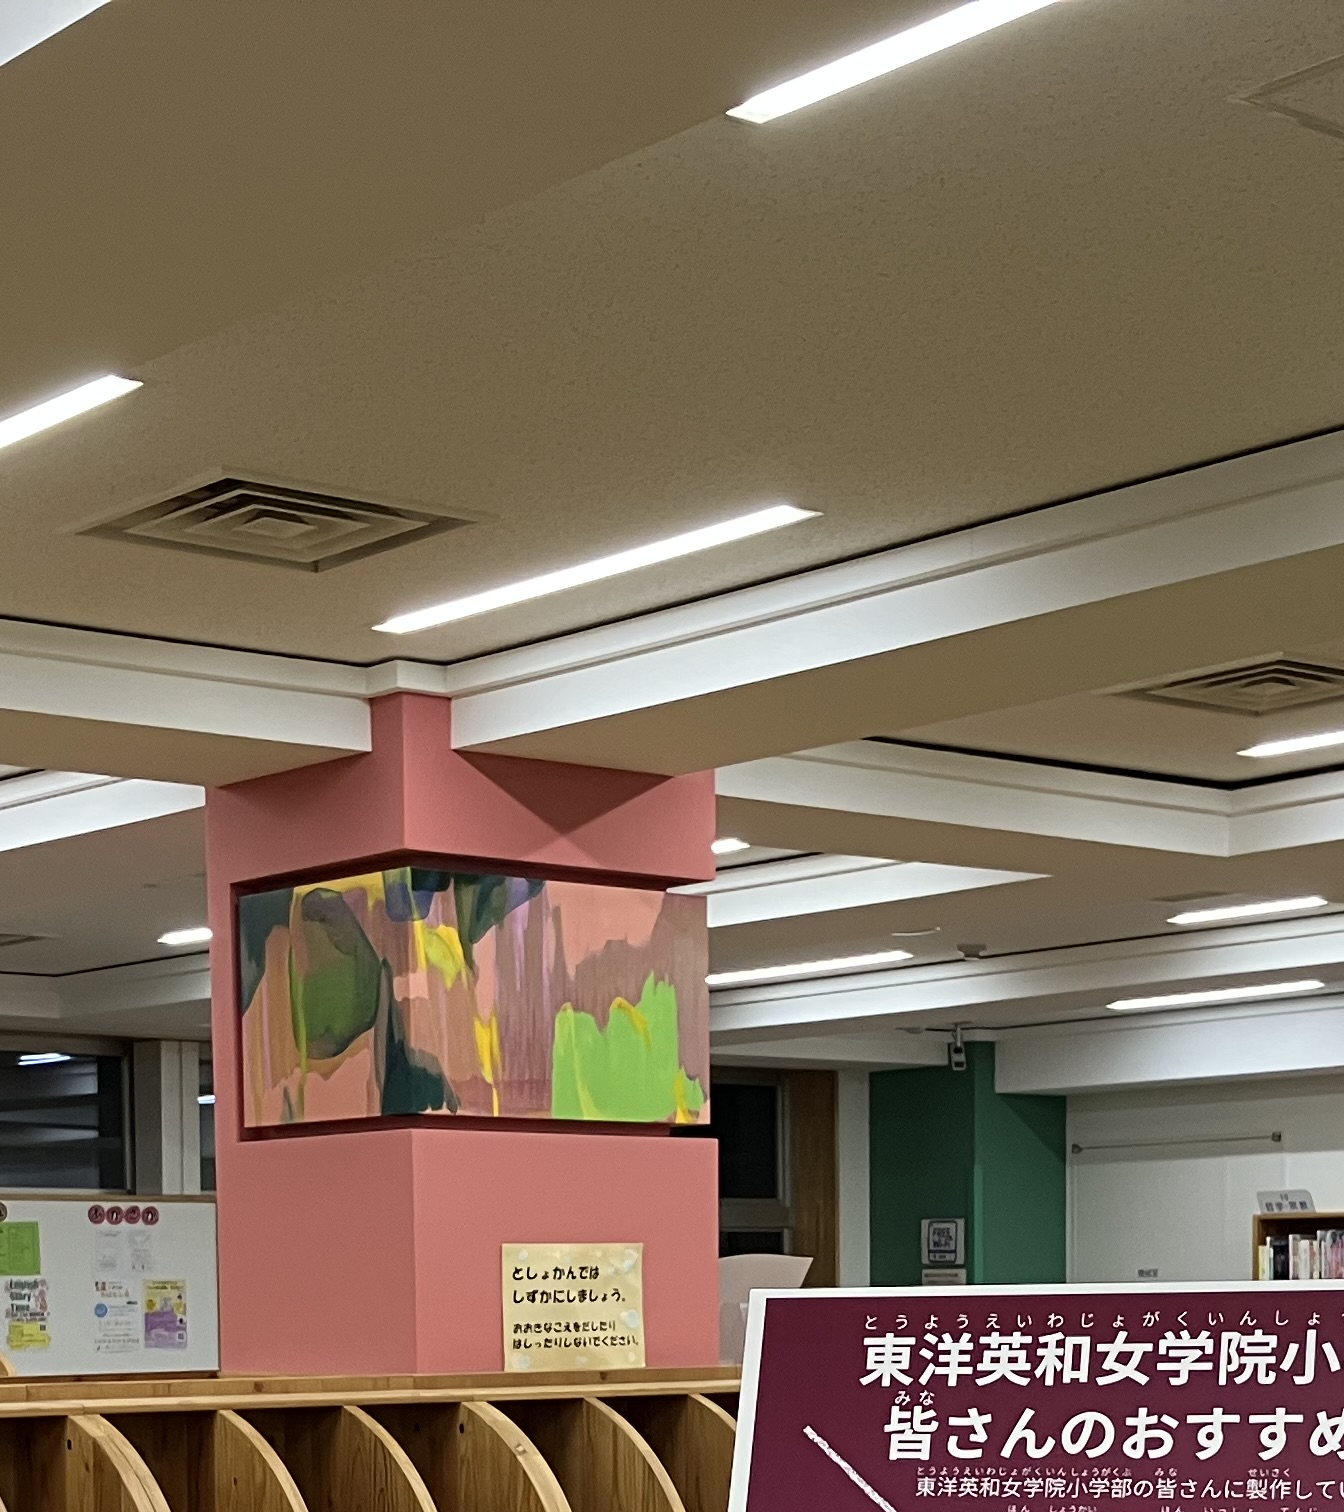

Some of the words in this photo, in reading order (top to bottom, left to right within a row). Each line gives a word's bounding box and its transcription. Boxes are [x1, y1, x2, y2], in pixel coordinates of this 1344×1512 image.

[512, 1265, 600, 1281] としょかんでは
[512, 1288, 627, 1304] しずかにしましょう。
[512, 1320, 616, 1335] おおきなこえをだしたり
[512, 1335, 640, 1350] はしったりしないでください。
[894, 1389, 935, 1407] みな
